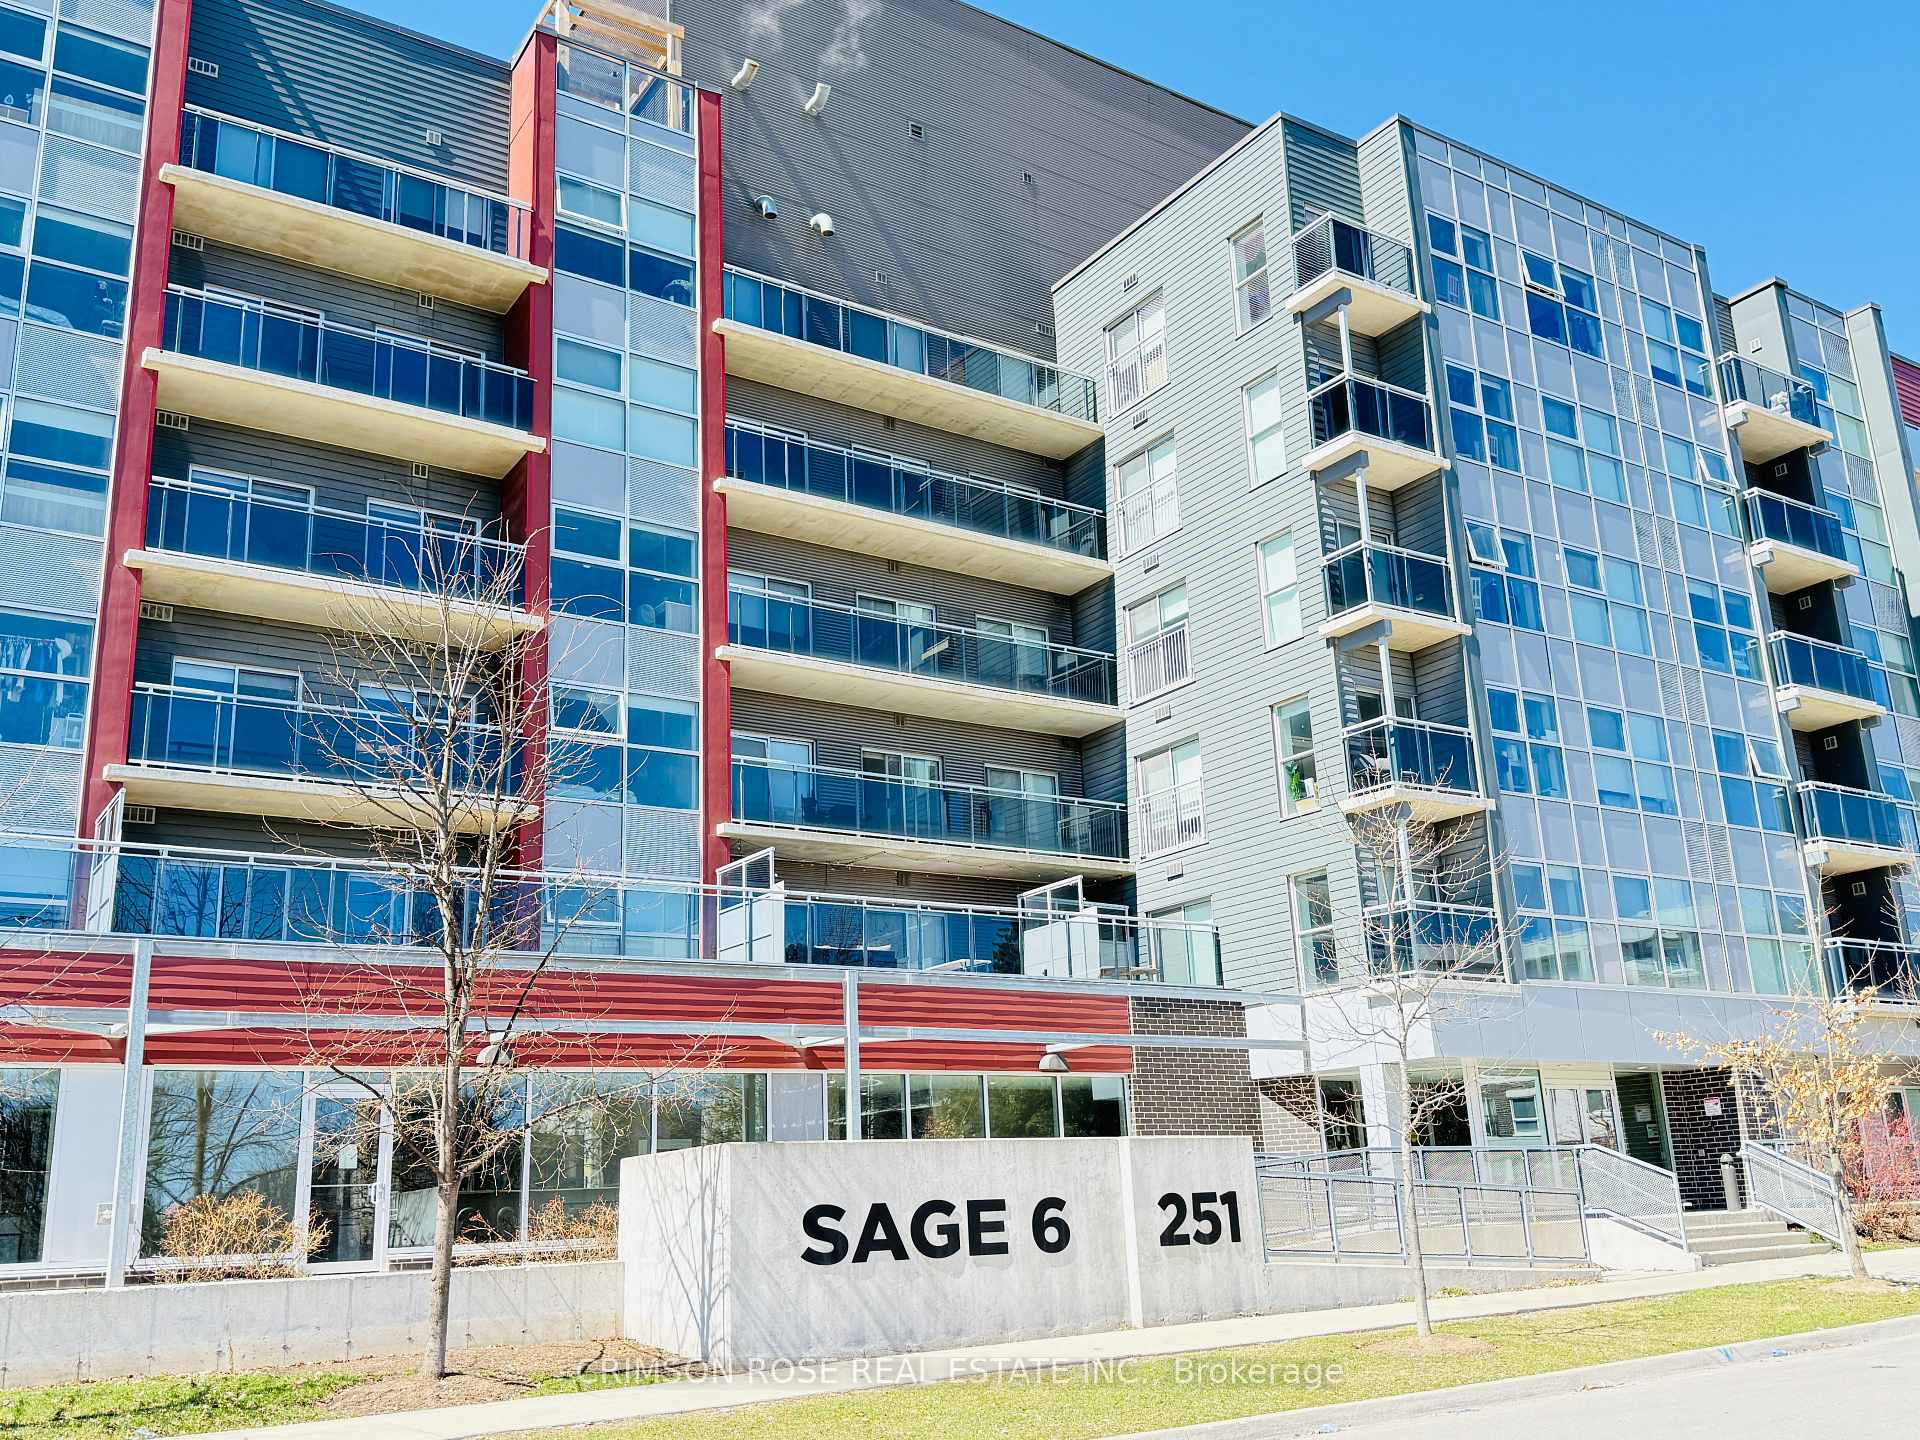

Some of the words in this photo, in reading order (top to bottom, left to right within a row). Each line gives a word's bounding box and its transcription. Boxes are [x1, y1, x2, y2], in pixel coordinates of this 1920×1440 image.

[801, 1198, 1009, 1265] SAGE
[1032, 1196, 1071, 1254] 6
[1158, 1190, 1242, 1247] 251
